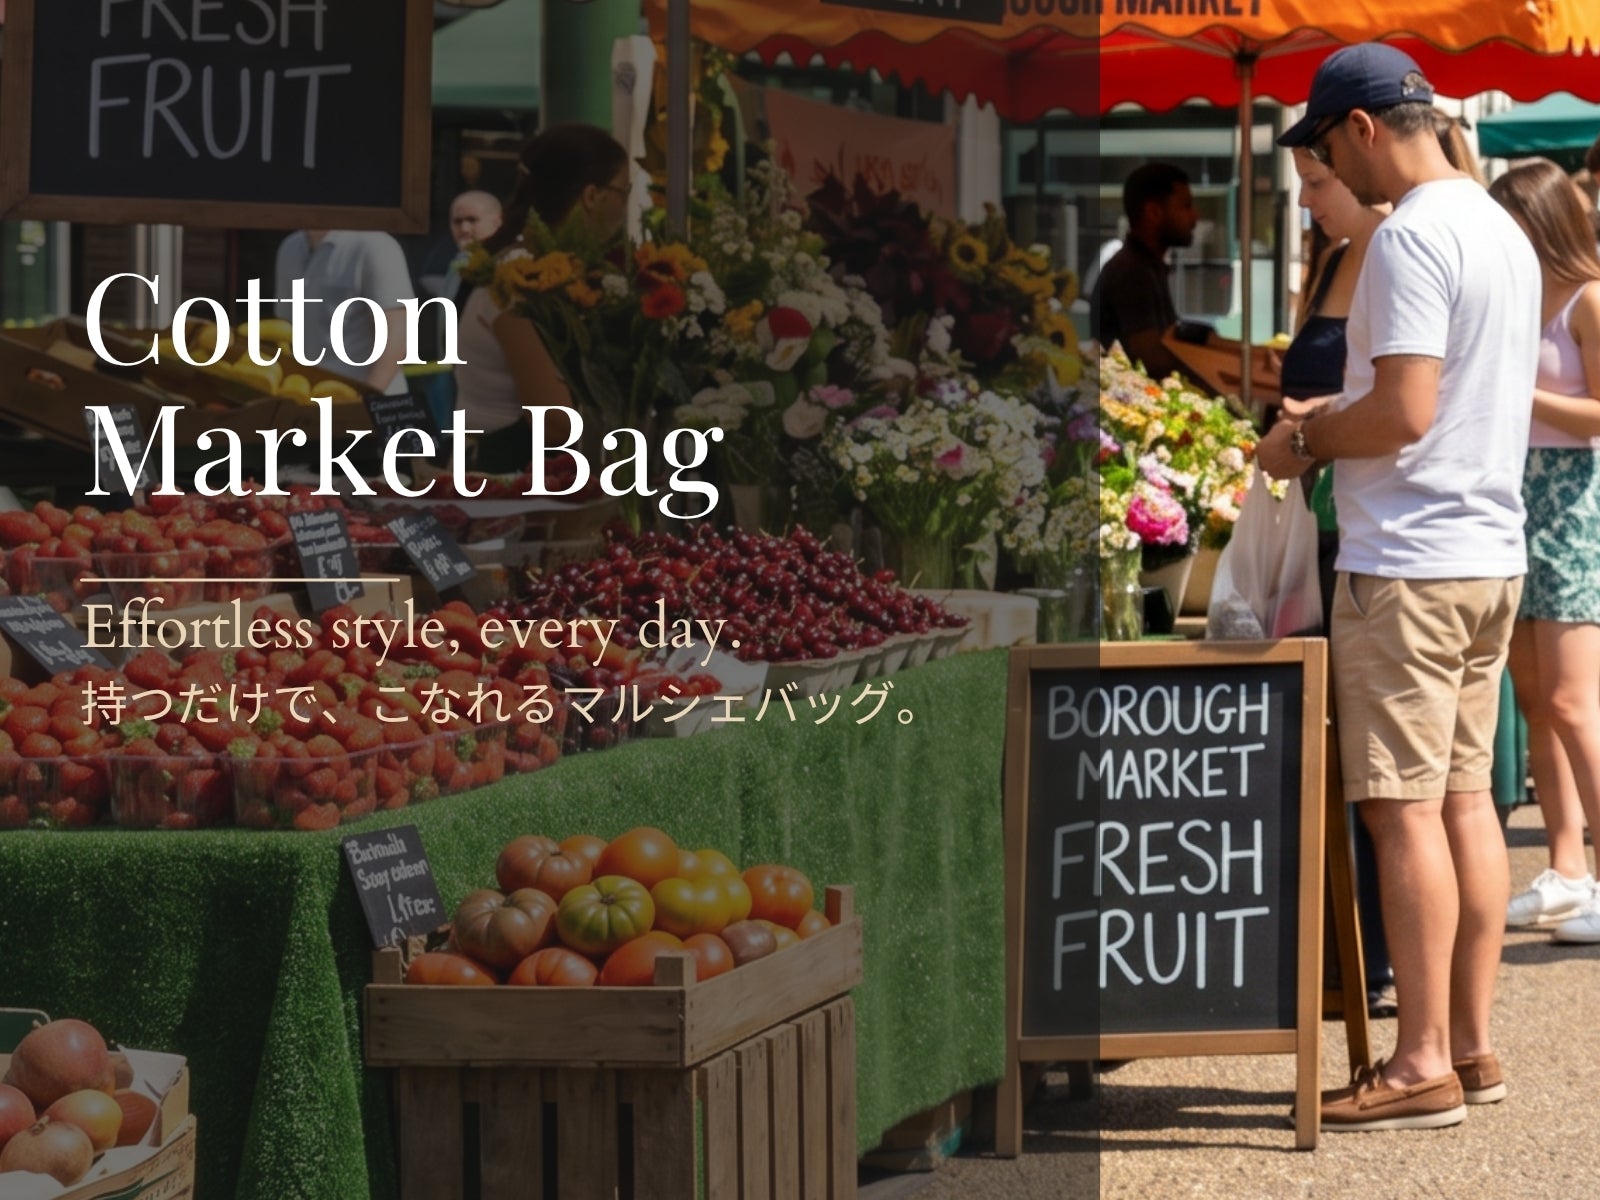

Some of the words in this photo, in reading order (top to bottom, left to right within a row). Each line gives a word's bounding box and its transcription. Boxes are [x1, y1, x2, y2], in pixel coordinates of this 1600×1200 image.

[88, 53, 352, 169] FRUIT
[1048, 682, 1269, 740] BOROUGH
[1077, 743, 1265, 800] MARKET
[1052, 819, 1263, 899] FRESH
[1053, 906, 1270, 991] FRUIT
